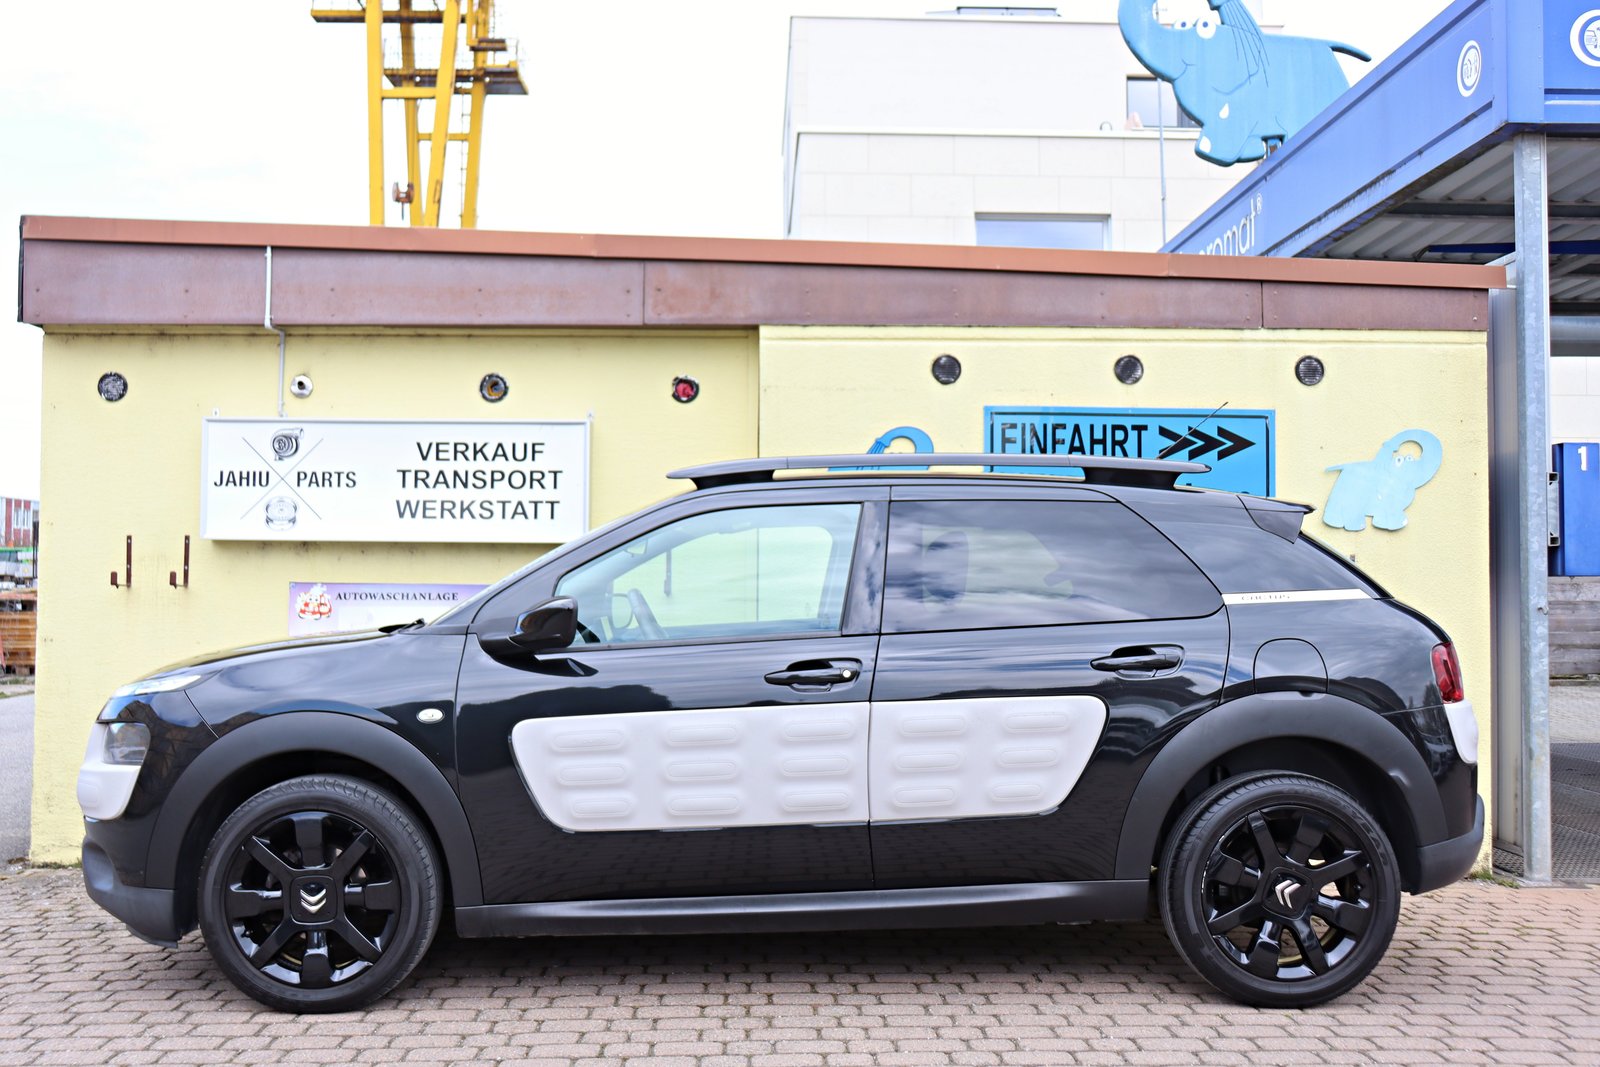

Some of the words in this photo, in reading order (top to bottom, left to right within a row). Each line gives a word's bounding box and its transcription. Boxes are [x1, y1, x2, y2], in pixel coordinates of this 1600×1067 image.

[1002, 422, 1147, 457] EINFAHRT
[415, 441, 545, 461] VERKAUF
[1577, 446, 1588, 471] 1
[213, 470, 270, 489] JAHIU
[296, 470, 357, 489] PARTS
[397, 469, 563, 489] TRANSPORT
[395, 499, 560, 520] WERKSTATT
[335, 590, 459, 601] AUTOWASCHANLAGE
